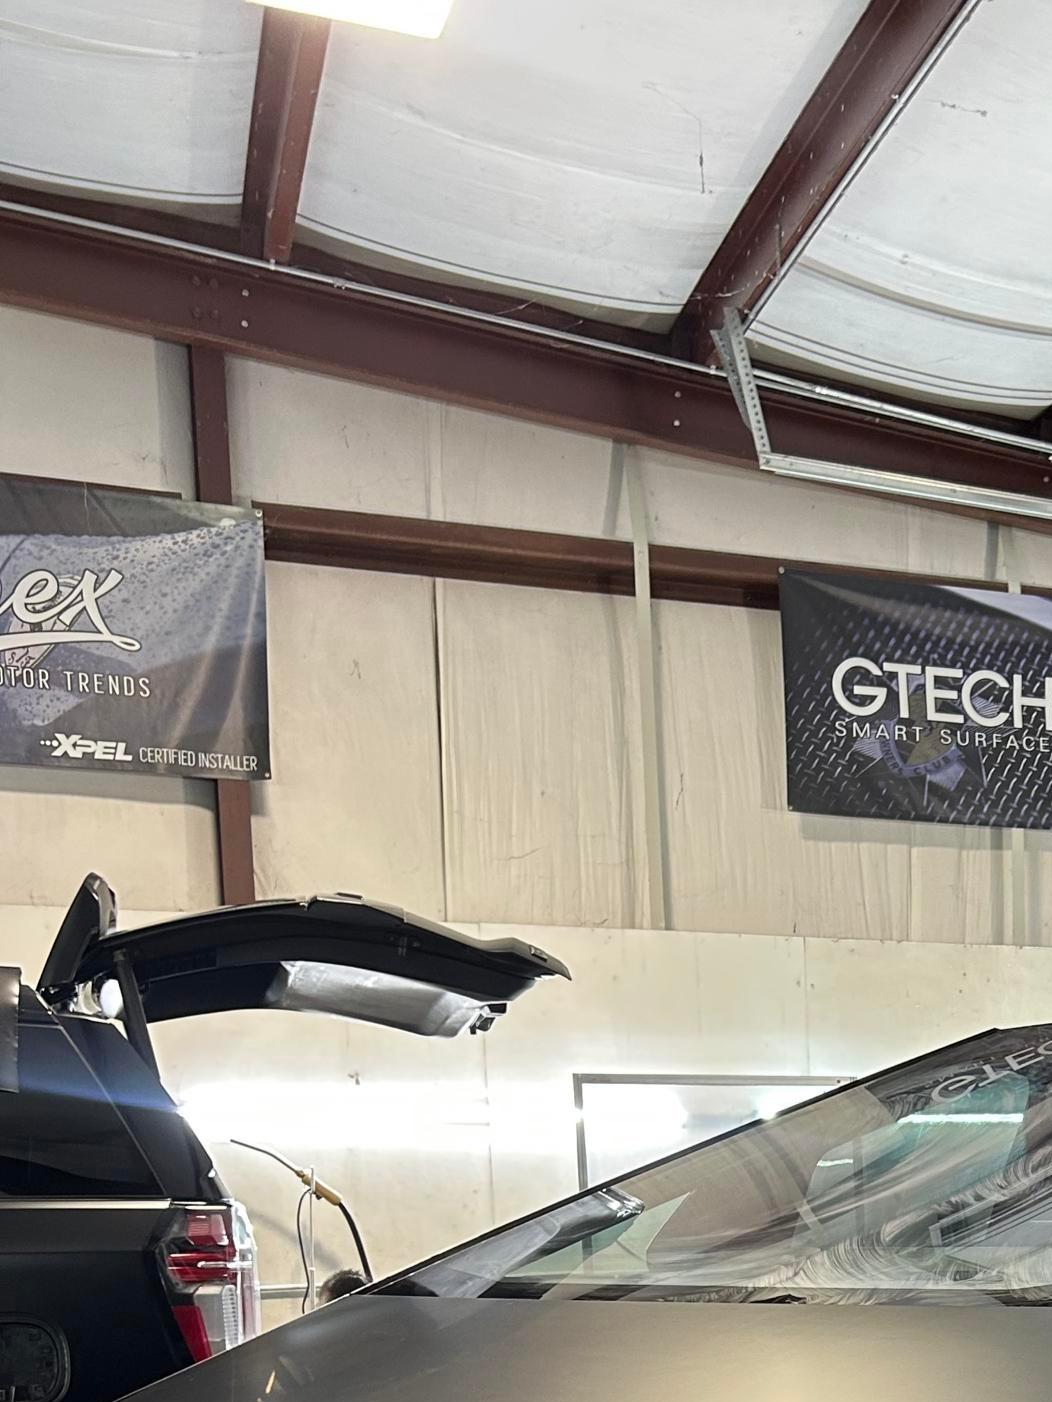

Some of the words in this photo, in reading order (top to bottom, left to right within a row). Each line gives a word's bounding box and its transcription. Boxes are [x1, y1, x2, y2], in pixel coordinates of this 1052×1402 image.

[0, 568, 142, 651] ex
[63, 670, 151, 698] TRENDS
[51, 733, 133, 762] XPEL
[139, 747, 196, 767] CERTIFIED
[198, 752, 258, 771] INSTALLER
[834, 719, 923, 743] SMART
[940, 728, 1051, 753] SURFACE
